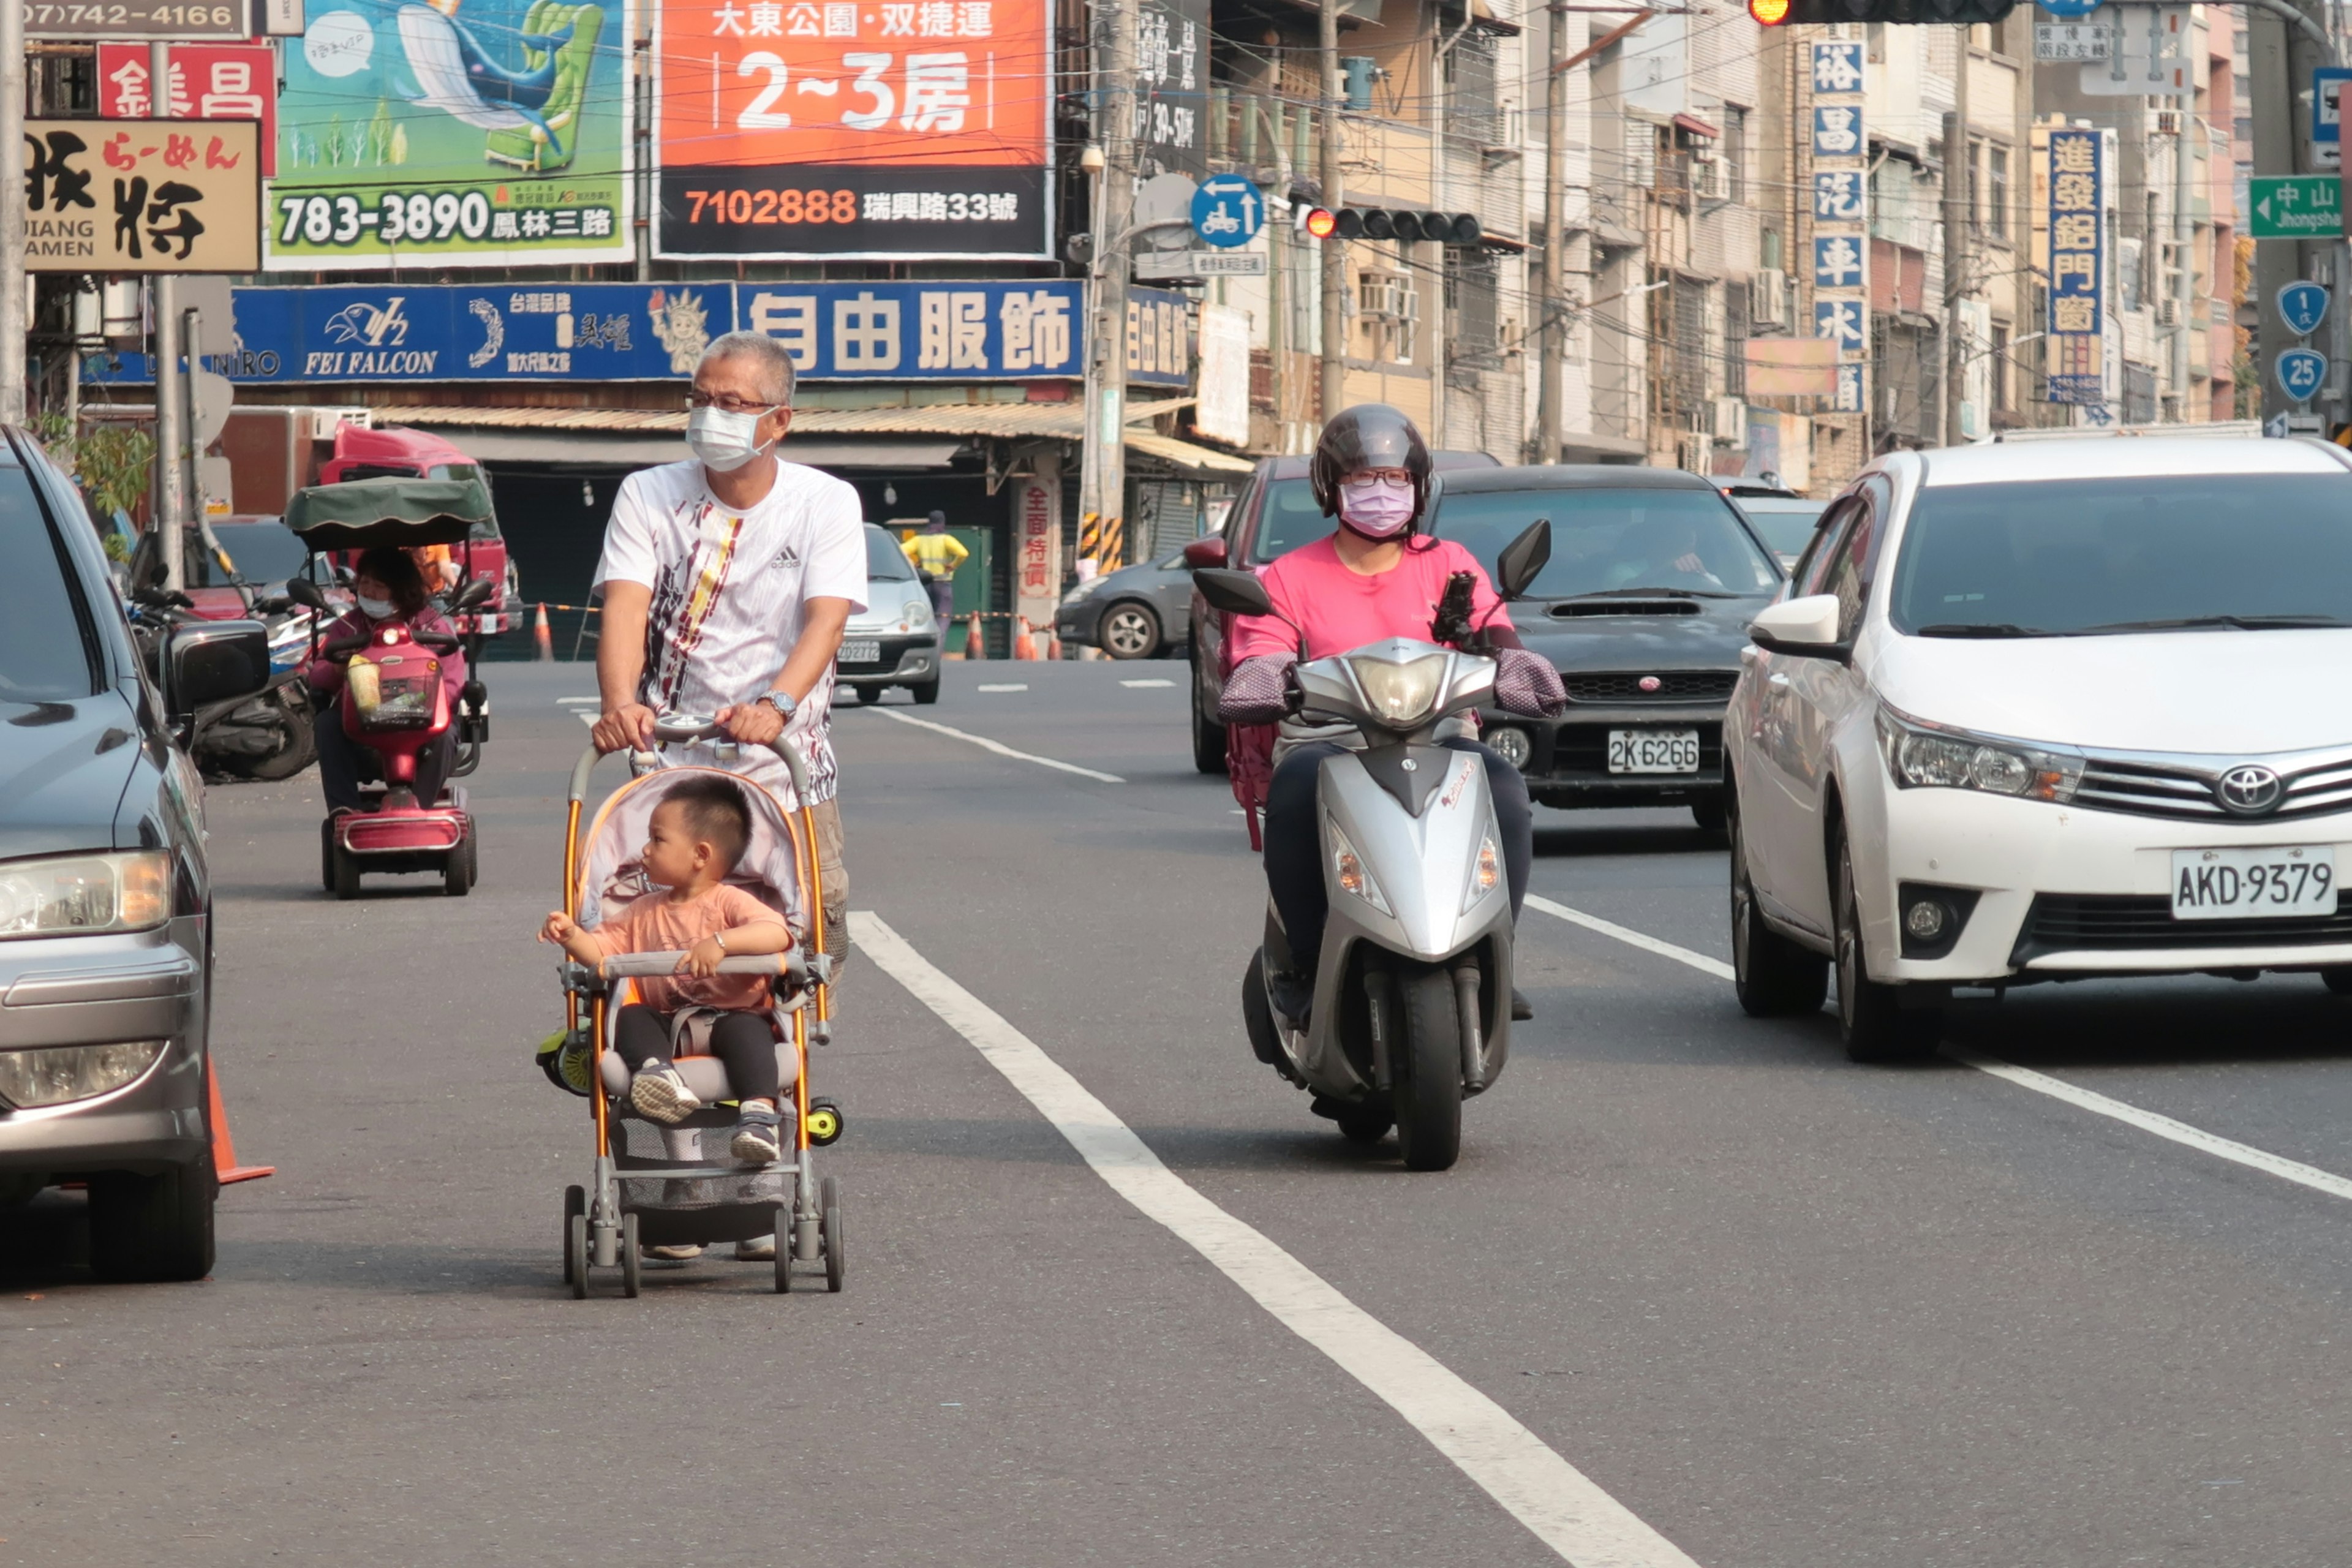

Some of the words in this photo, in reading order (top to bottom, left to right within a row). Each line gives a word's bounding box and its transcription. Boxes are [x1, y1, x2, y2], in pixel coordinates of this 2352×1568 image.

[103, 132, 241, 172] らーめん
[685, 189, 856, 224] 7102888
[862, 192, 1018, 221] 瑞興路33號
[2276, 182, 2334, 208] 中山
[280, 193, 489, 243] 783-3890
[491, 208, 611, 239] 鳳林三路
[2054, 135, 2097, 331] 進發鋁門窗
[2275, 209, 2342, 232] Jhongsha
[24, 241, 94, 256] AMEN
[750, 290, 1071, 371] 自由服飾
[304, 352, 345, 375] FEI
[346, 350, 439, 375] FALCON
[2290, 360, 2315, 386] 25
[1610, 739, 1697, 766] 2K-6266
[2178, 862, 2331, 907] AKD-9379
